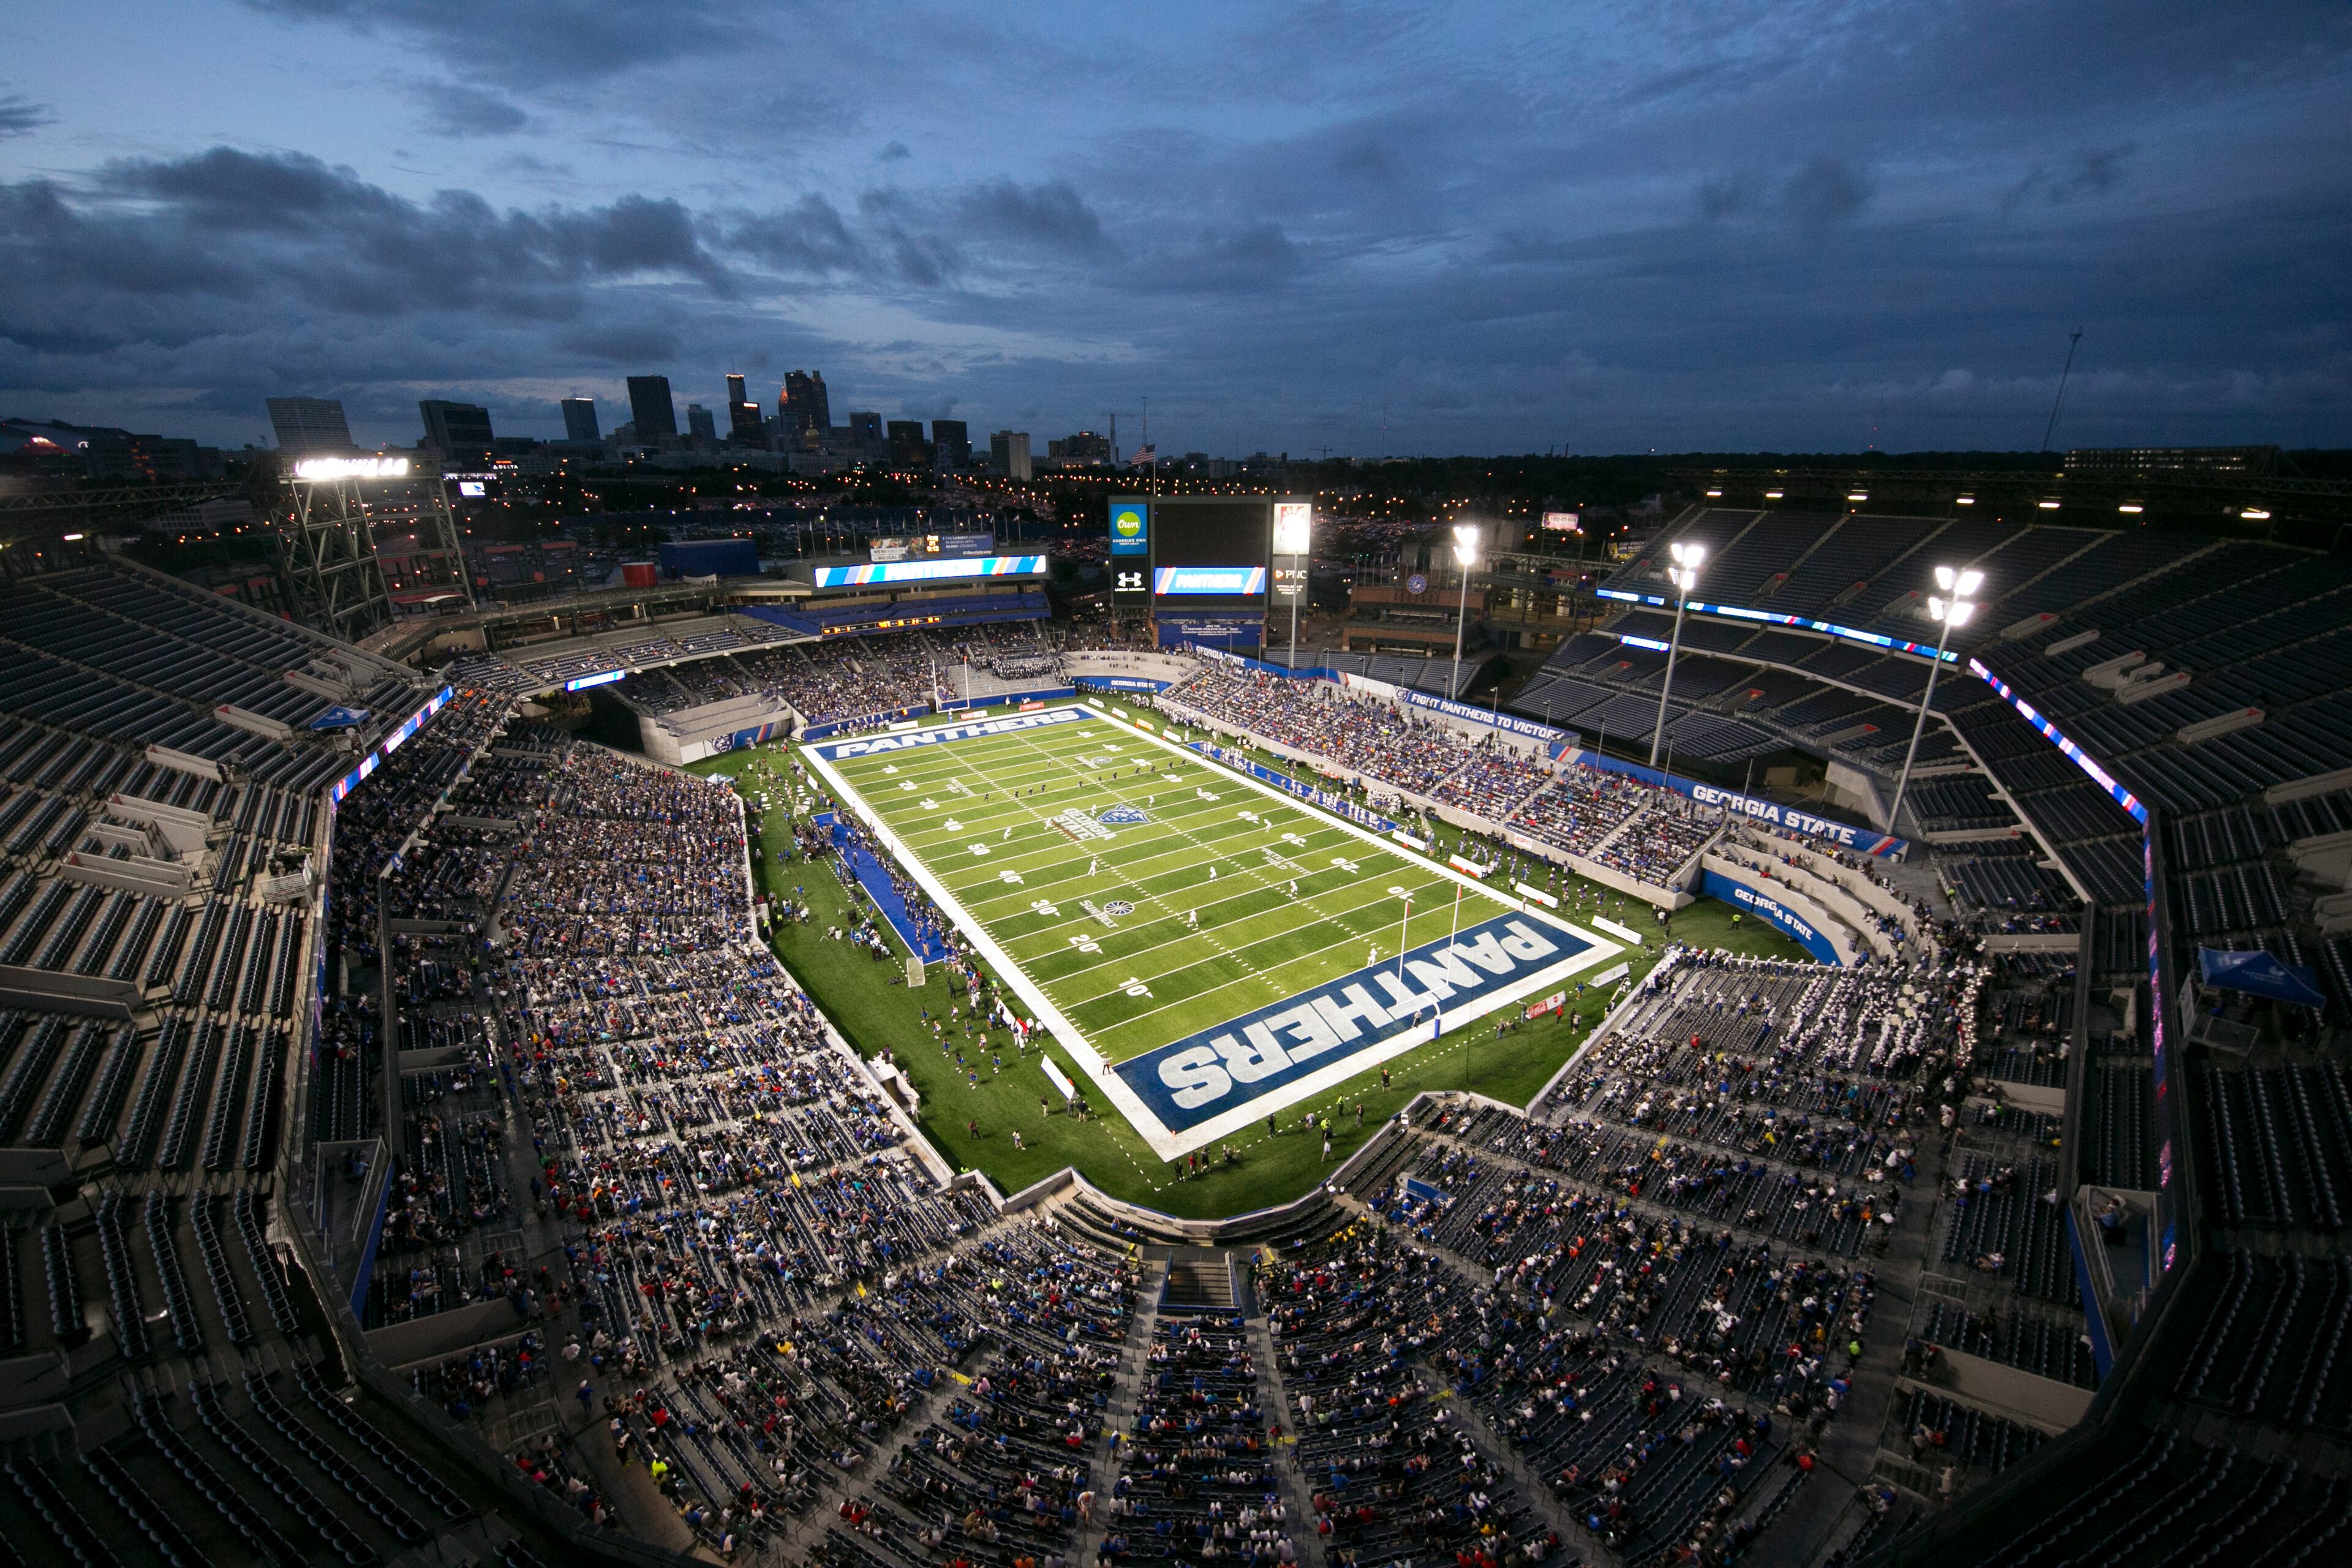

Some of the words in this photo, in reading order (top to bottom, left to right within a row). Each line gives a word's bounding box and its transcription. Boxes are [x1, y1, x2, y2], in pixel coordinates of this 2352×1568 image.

[1118, 519, 1139, 529] Own
[1196, 645, 1224, 660] GEORGIA
[1224, 654, 1246, 667] STATE
[1411, 693, 1440, 710] FIGHT
[1440, 701, 1494, 724] PANTHERS
[1497, 715, 1512, 729] TO
[835, 710, 1080, 758] PANTHERS
[899, 781, 918, 791] 20
[1196, 787, 1221, 802] 50
[919, 799, 940, 810] 30
[1693, 785, 1779, 822] GEORGIA
[1785, 811, 1856, 845] STATE
[943, 820, 964, 832] 40
[1052, 816, 1096, 840] STATE
[1063, 808, 1117, 841] GEORGIA
[1281, 832, 1307, 845] 30
[968, 843, 991, 856] 50
[1262, 856, 1287, 870] FIELD
[1330, 858, 1360, 871] 20
[998, 870, 1022, 883] 40
[1387, 886, 1414, 899] 10
[1031, 899, 1058, 915] 30
[1079, 900, 1101, 915] SUN
[1095, 912, 1119, 928] BELT
[1735, 888, 1782, 920] GEORGIA
[1785, 914, 1813, 940] STATE
[1068, 933, 1099, 952] 20
[1118, 976, 1148, 997] 10
[1158, 920, 1560, 1109] PANTHERS
